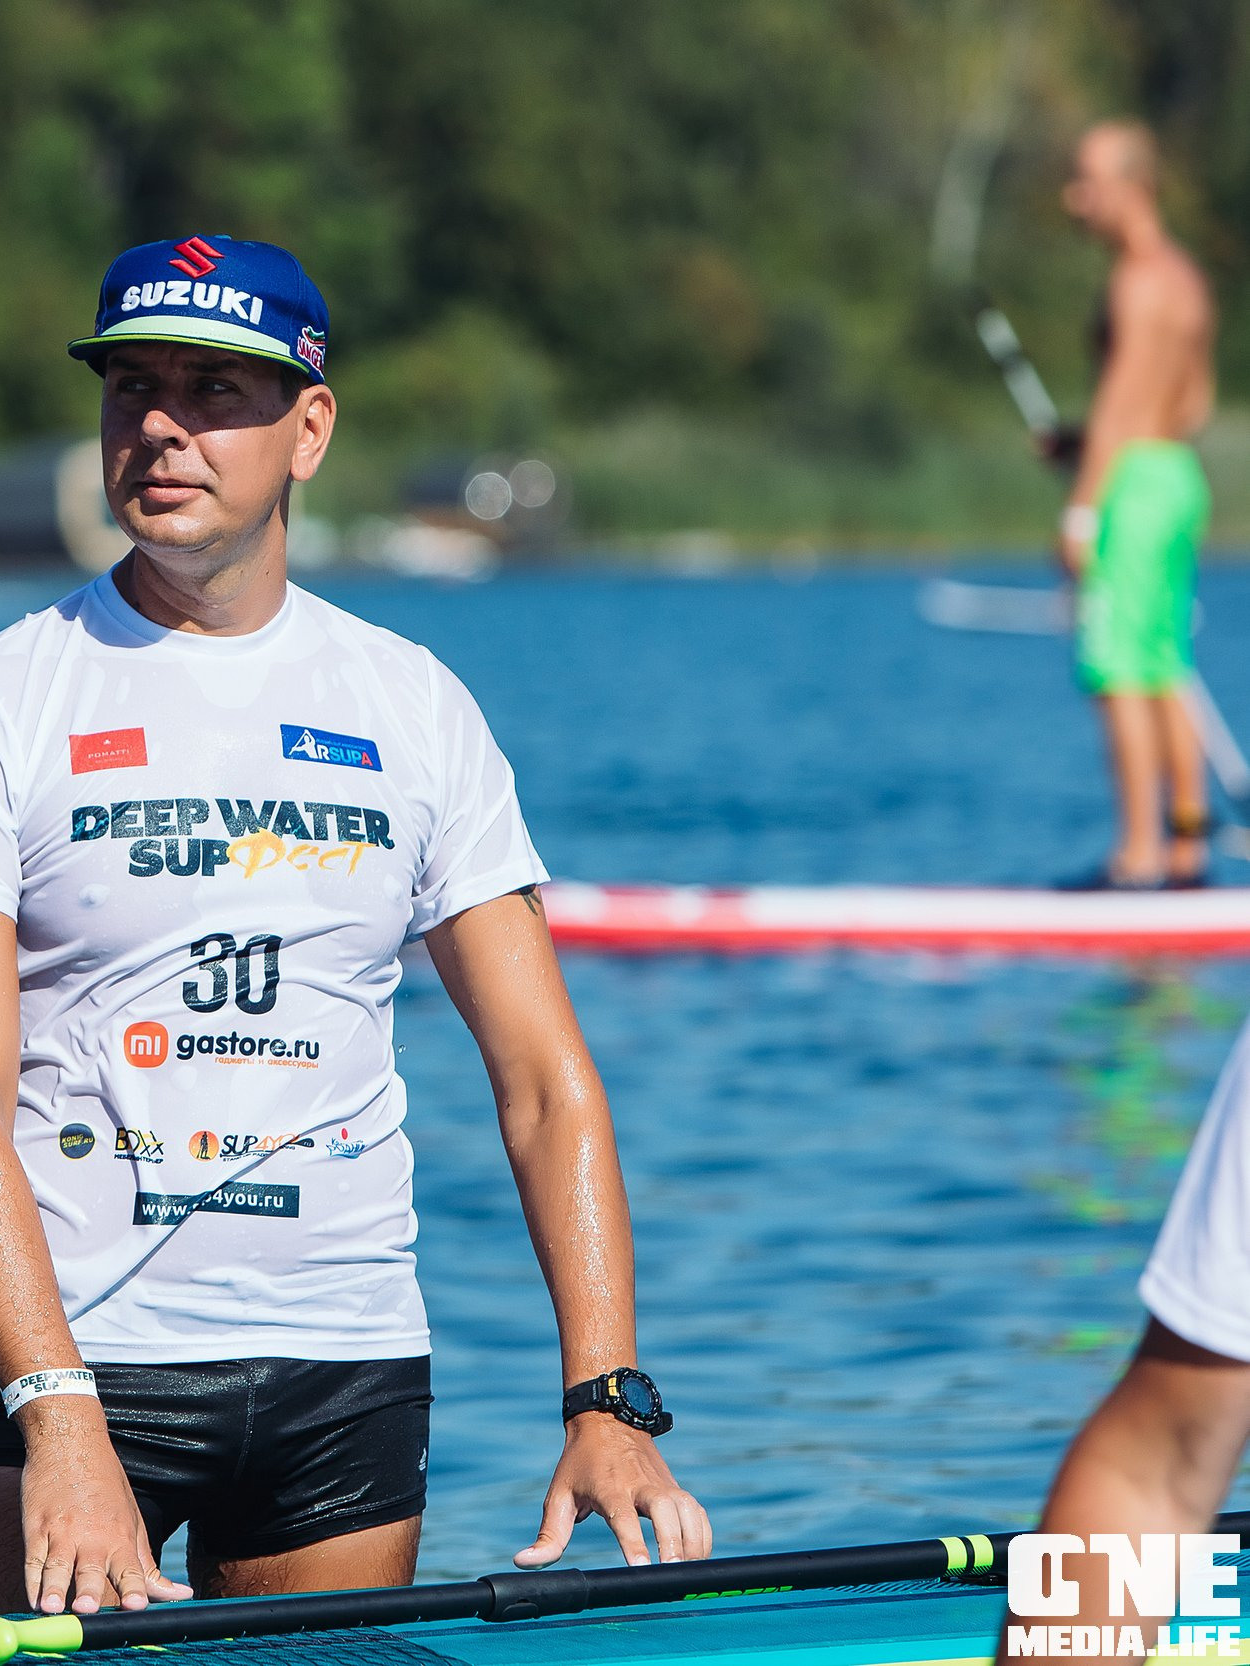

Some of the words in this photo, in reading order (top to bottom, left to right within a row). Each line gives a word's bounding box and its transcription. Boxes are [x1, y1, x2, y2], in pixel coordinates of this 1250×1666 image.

[121, 280, 263, 325] SUZUKI
[87, 749, 130, 758] POMATTI
[70, 798, 209, 842] DEEP
[215, 798, 395, 850] WATER
[183, 932, 283, 1014] 30
[176, 1030, 319, 1060] gastore.ru
[214, 1056, 255, 1065] гаджеты
[267, 1059, 319, 1069] аксессуары
[20, 1373, 52, 1389] DEEP
[54, 1371, 95, 1383] WATER
[35, 1381, 59, 1393] SUP
